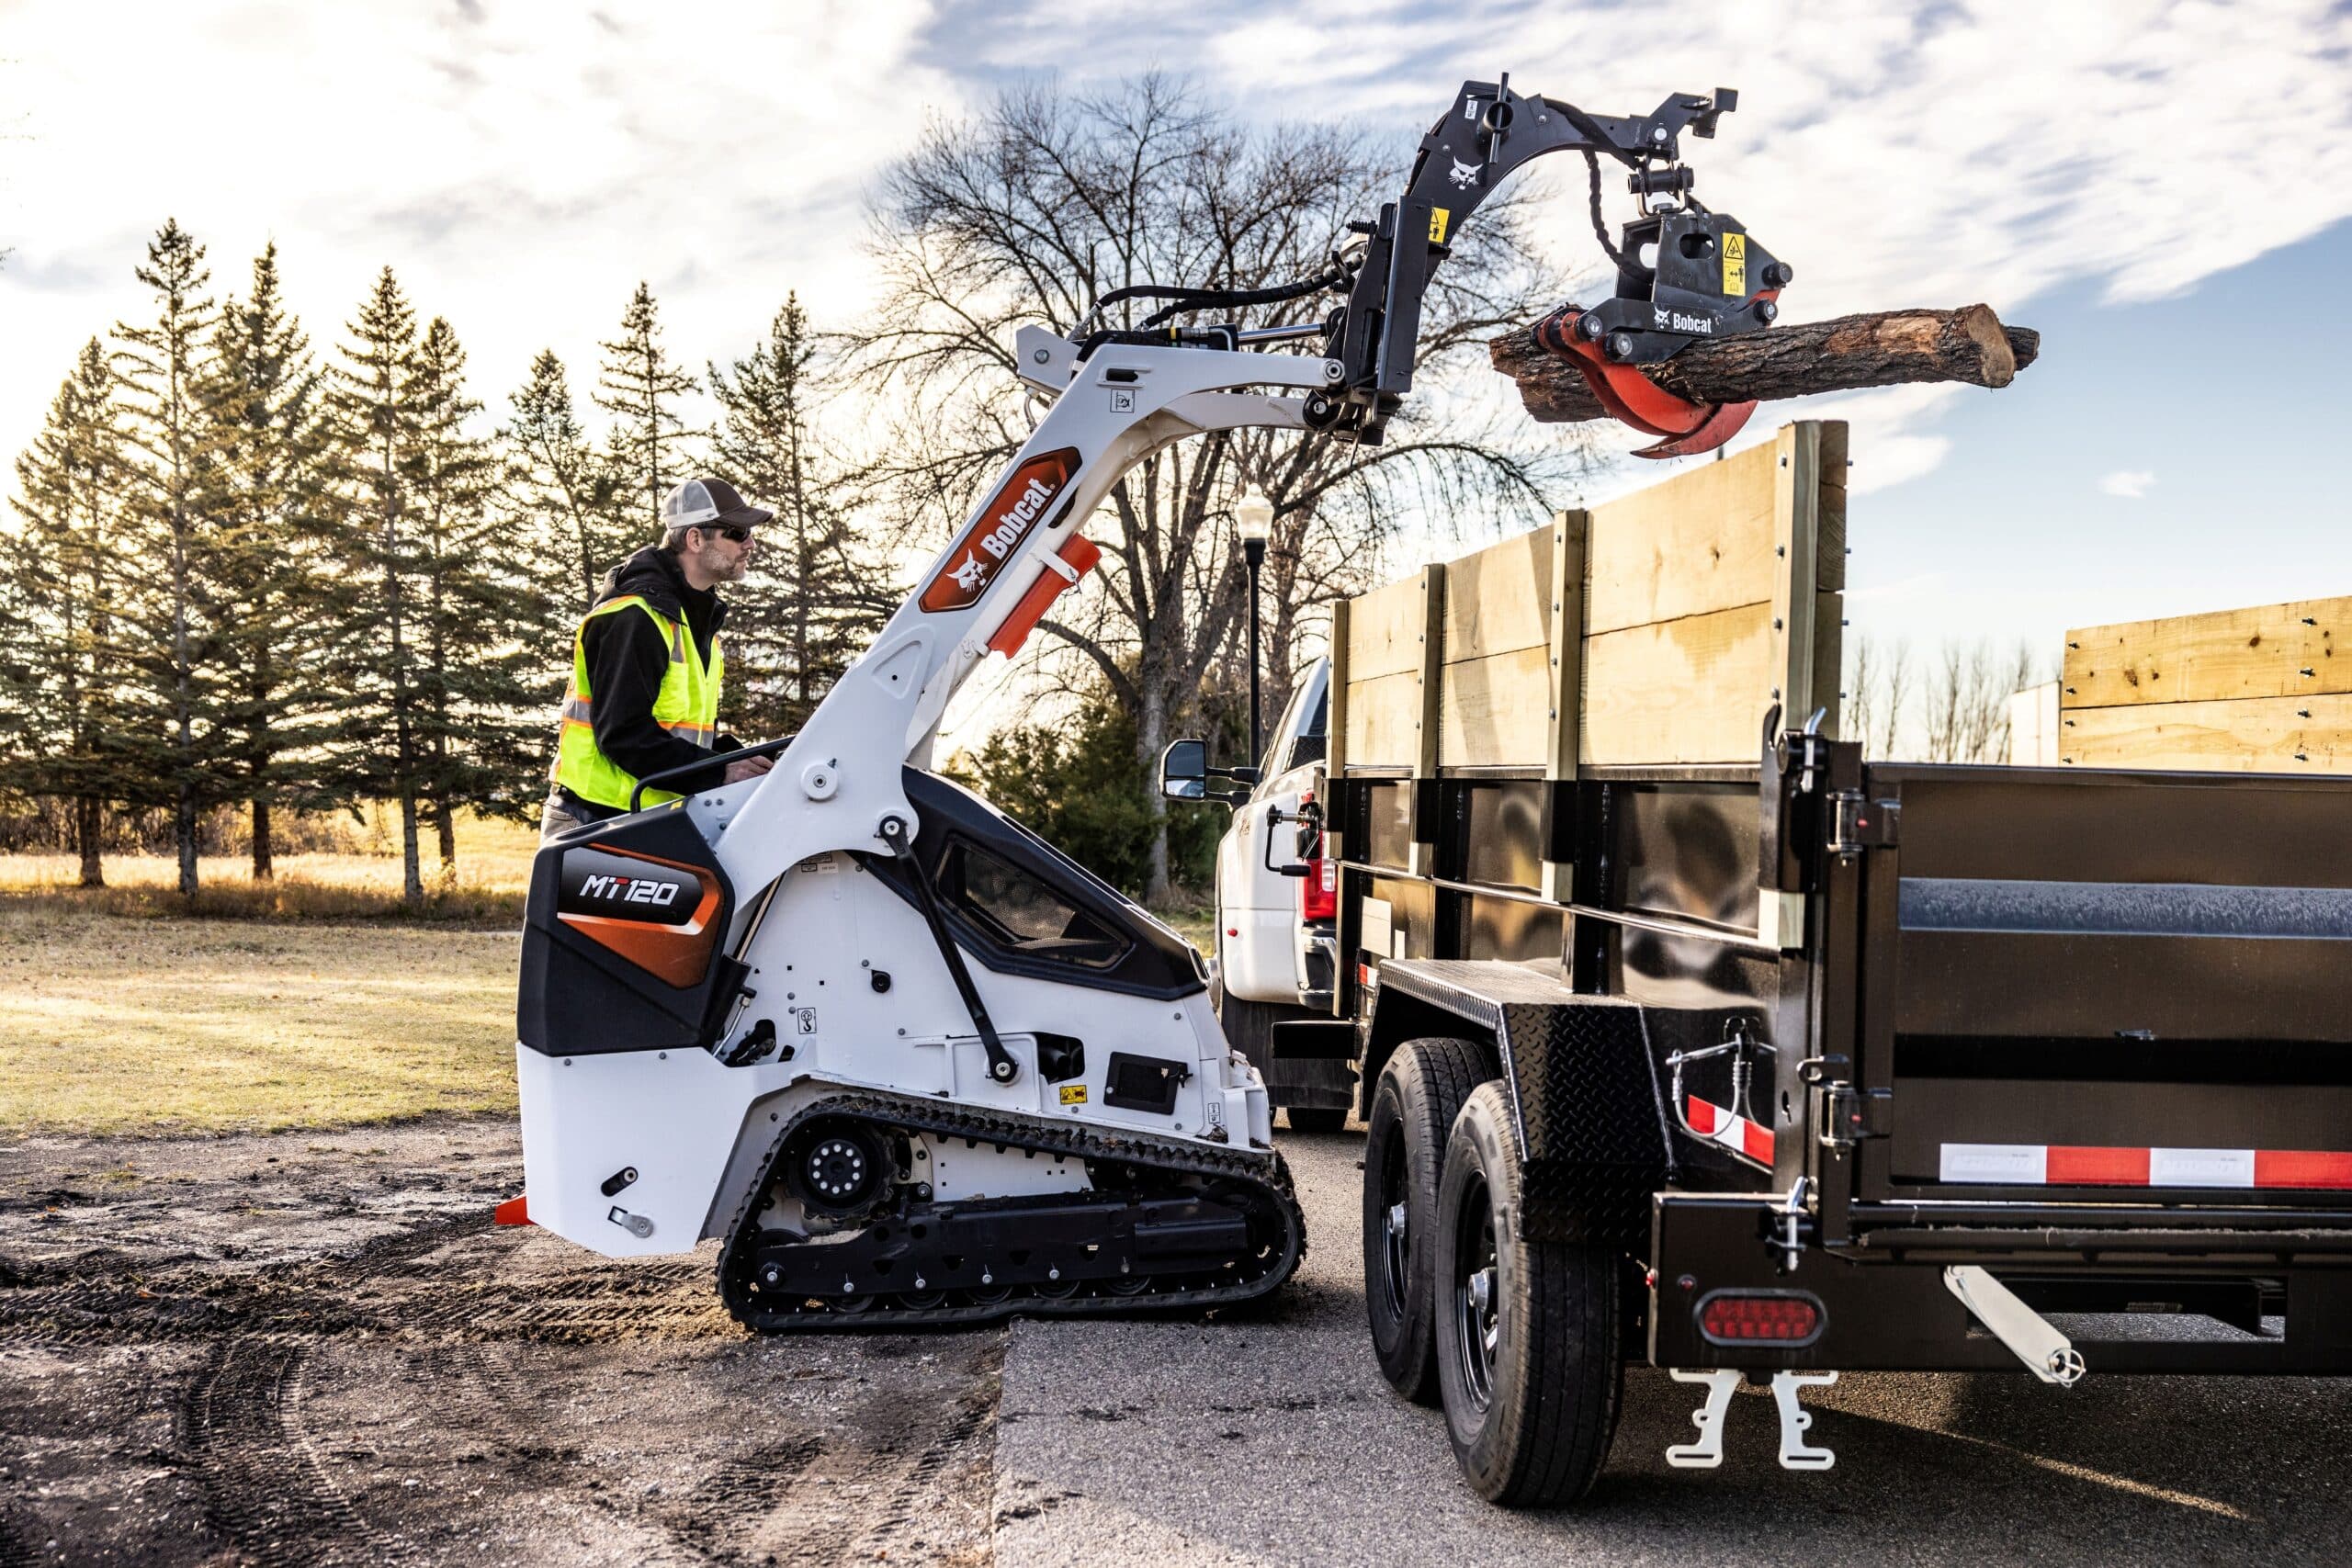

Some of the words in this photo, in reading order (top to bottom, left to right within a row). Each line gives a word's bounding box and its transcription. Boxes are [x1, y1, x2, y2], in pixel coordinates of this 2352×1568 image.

[1673, 312, 1712, 333] Bobcat
[979, 478, 1053, 559] Bobcat
[579, 874, 680, 906] MT120
